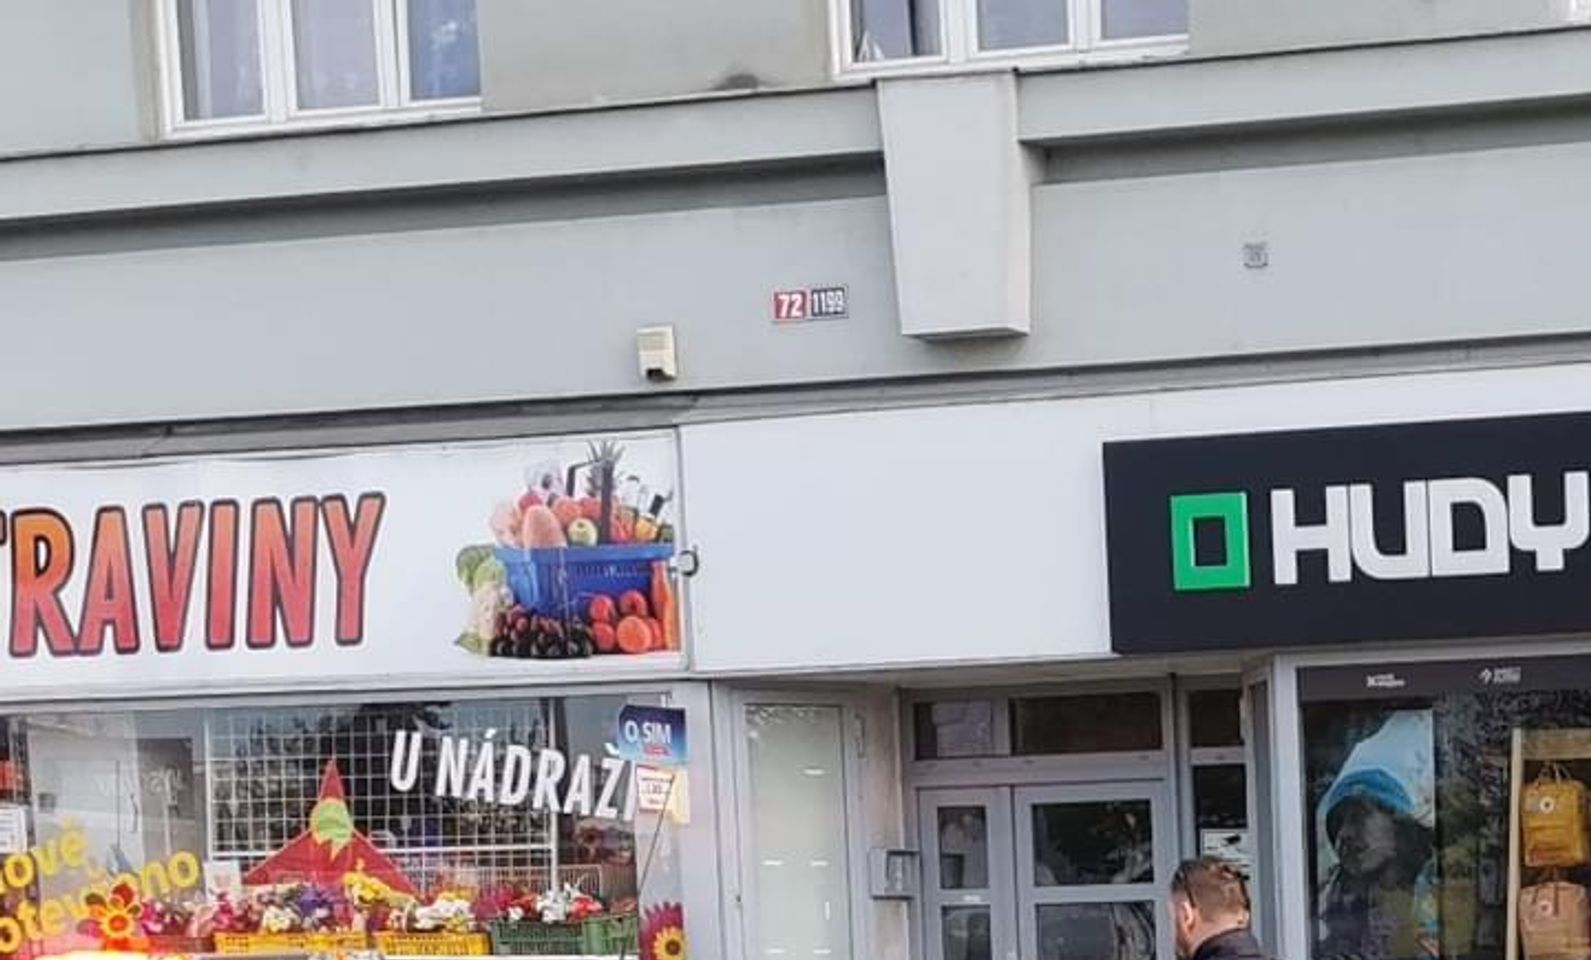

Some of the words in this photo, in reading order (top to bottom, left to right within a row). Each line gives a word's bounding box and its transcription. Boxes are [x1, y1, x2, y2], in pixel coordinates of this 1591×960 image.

[778, 293, 803, 318] 72
[1270, 470, 1590, 585] HUDY
[0, 490, 386, 658] RAVINY
[390, 729, 422, 793] U
